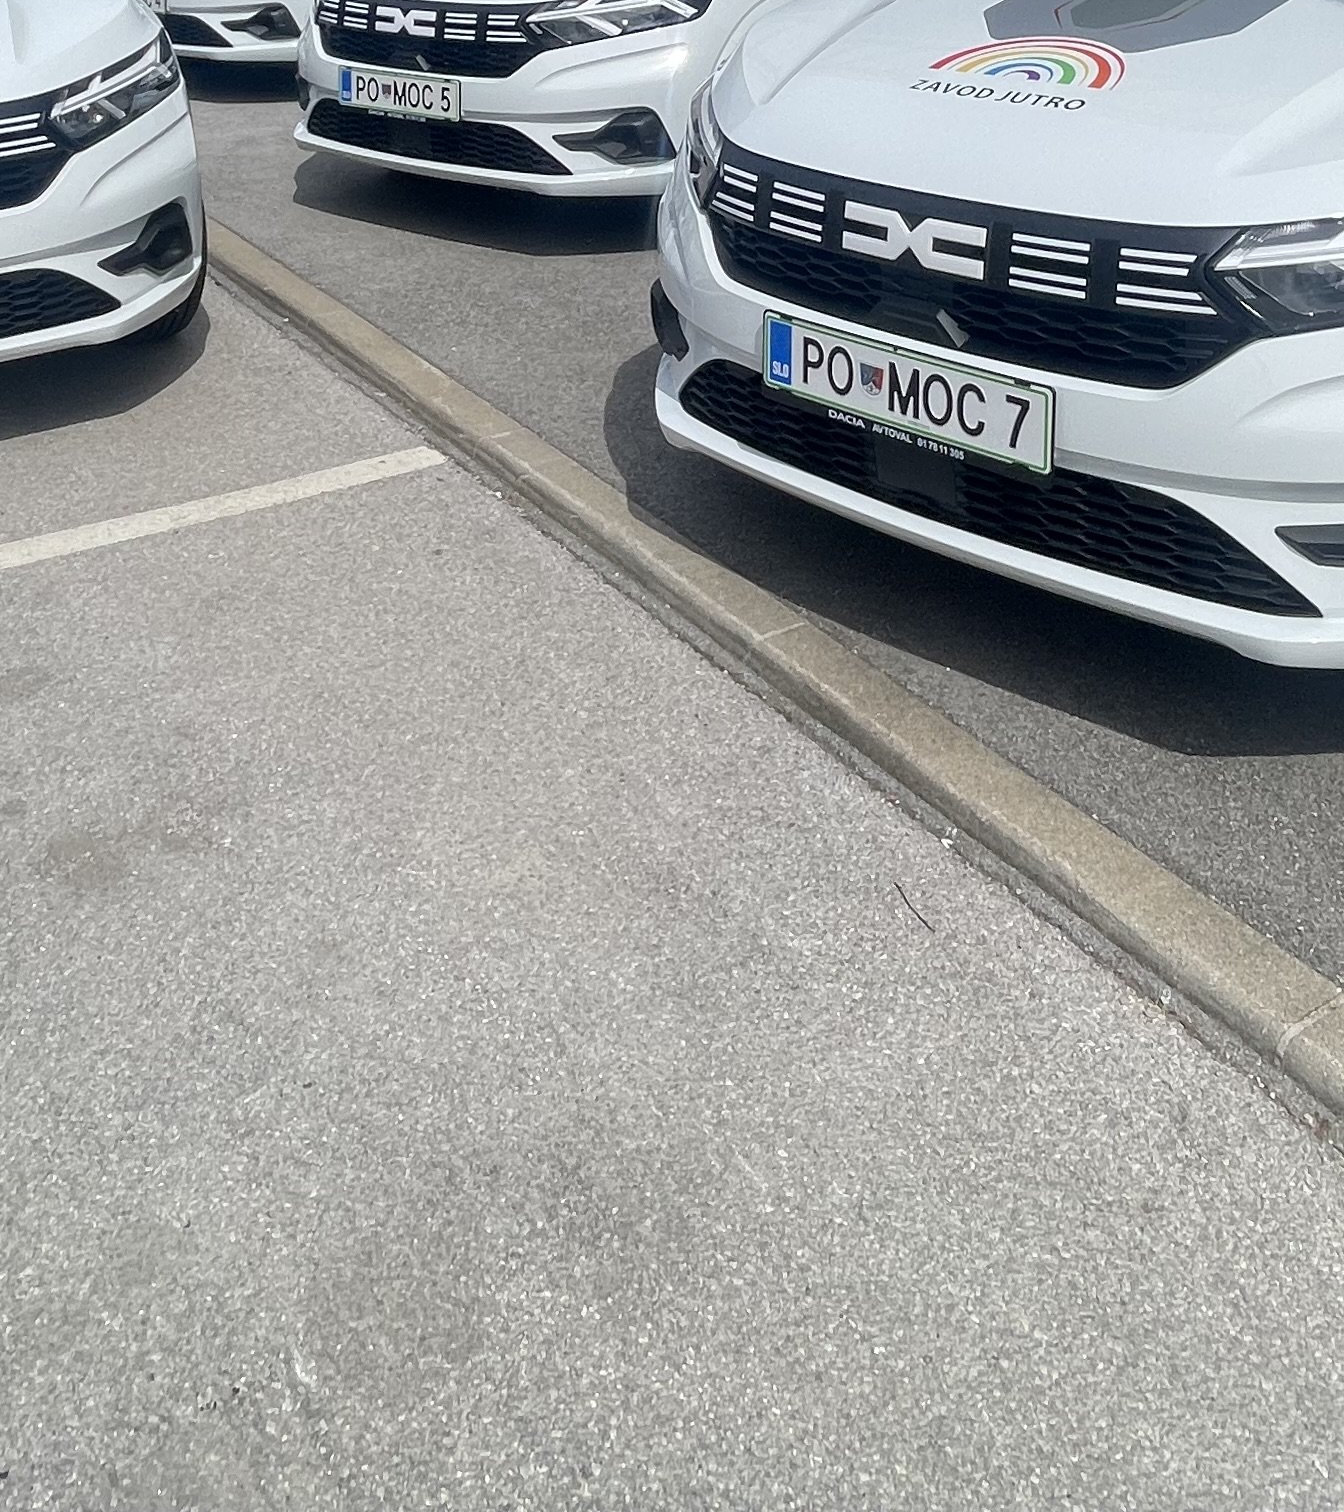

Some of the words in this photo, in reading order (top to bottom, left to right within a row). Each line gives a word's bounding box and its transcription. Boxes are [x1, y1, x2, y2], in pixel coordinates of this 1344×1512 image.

[356, 76, 379, 102] PO
[393, 80, 433, 110] MOC
[440, 86, 451, 112] 5
[909, 79, 995, 99] ZAVOD
[994, 90, 1086, 111] JUTRO
[772, 361, 789, 379] SLO
[802, 336, 854, 396] PO
[888, 361, 986, 437] MOC
[1005, 394, 1031, 449] 7
[828, 409, 866, 430] DACIA
[872, 423, 913, 444] AVTOVAL
